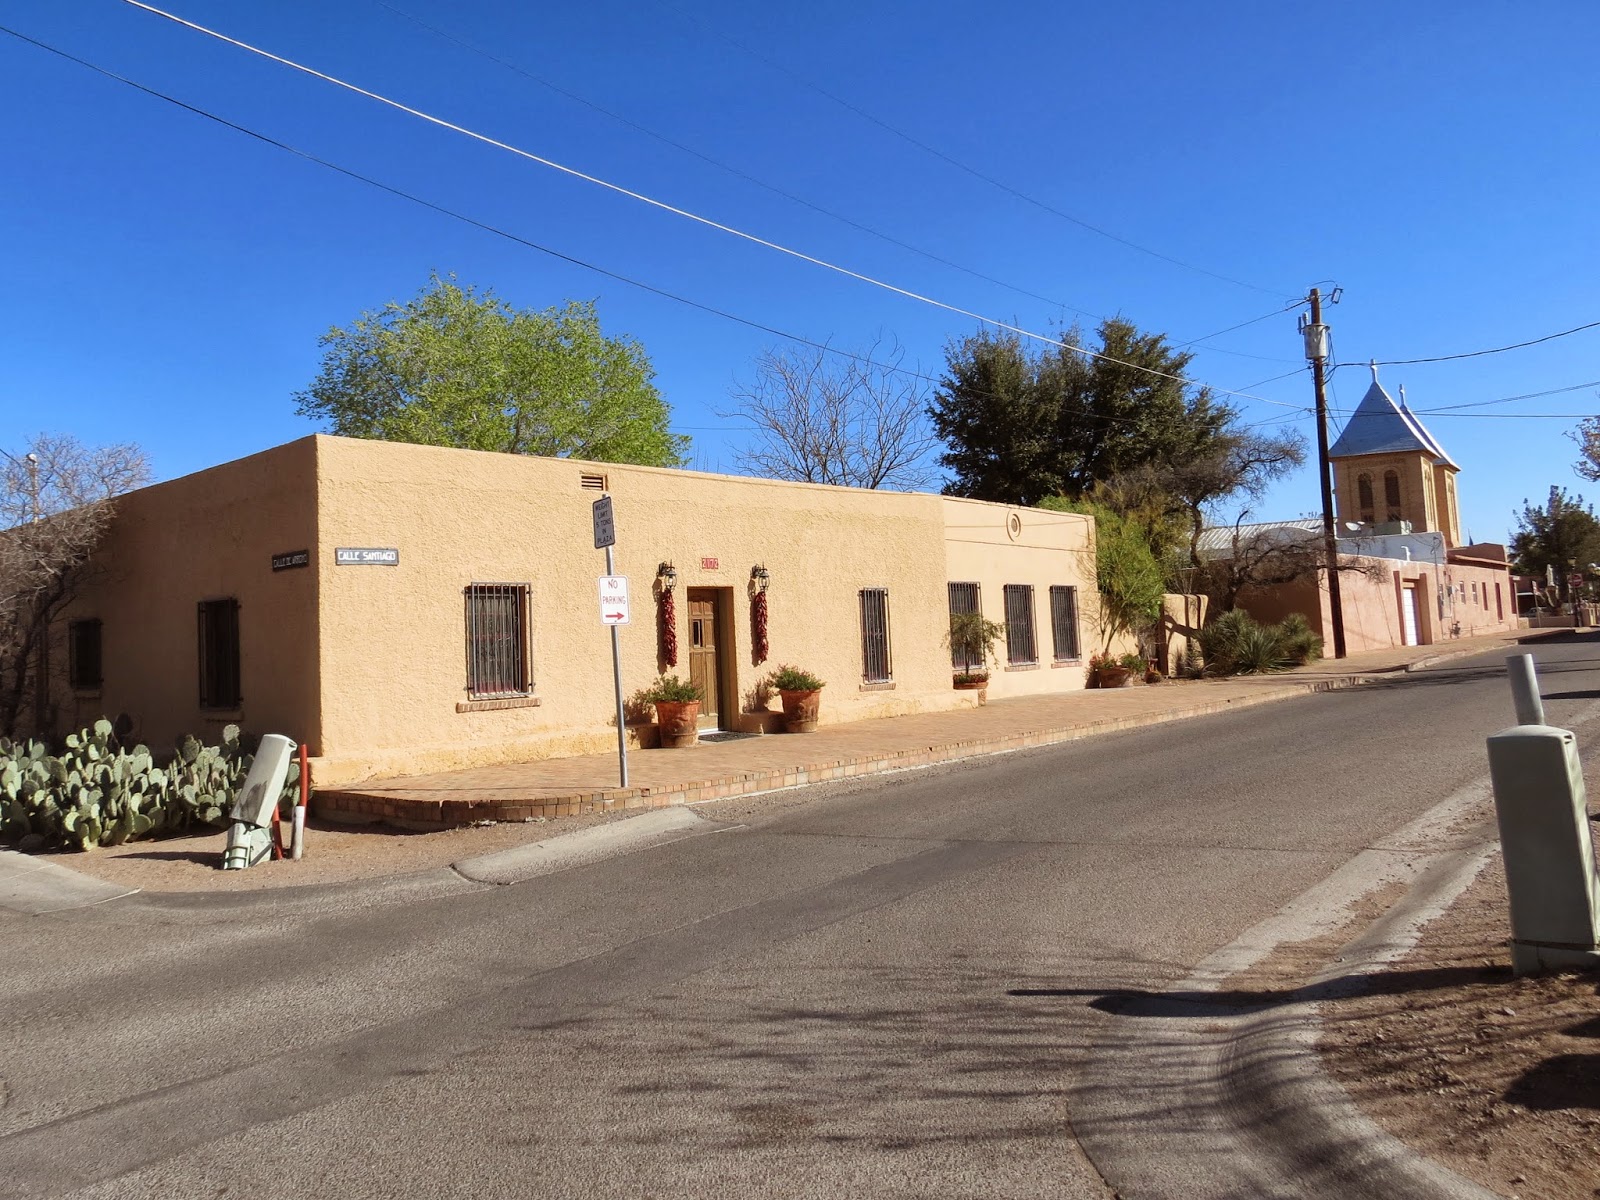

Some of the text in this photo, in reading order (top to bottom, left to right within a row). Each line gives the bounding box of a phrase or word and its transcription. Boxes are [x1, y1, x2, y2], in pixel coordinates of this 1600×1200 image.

[595, 501, 609, 511] WEIGHT
[597, 510, 608, 519] LIMIT
[596, 518, 611, 529] 5 TONS
[597, 535, 612, 544] PLAZA
[337, 551, 396, 561] CALLE SANTIAGO
[273, 557, 286, 568] CALLE
[607, 579, 618, 589] NO
[602, 595, 626, 605] PARKING
